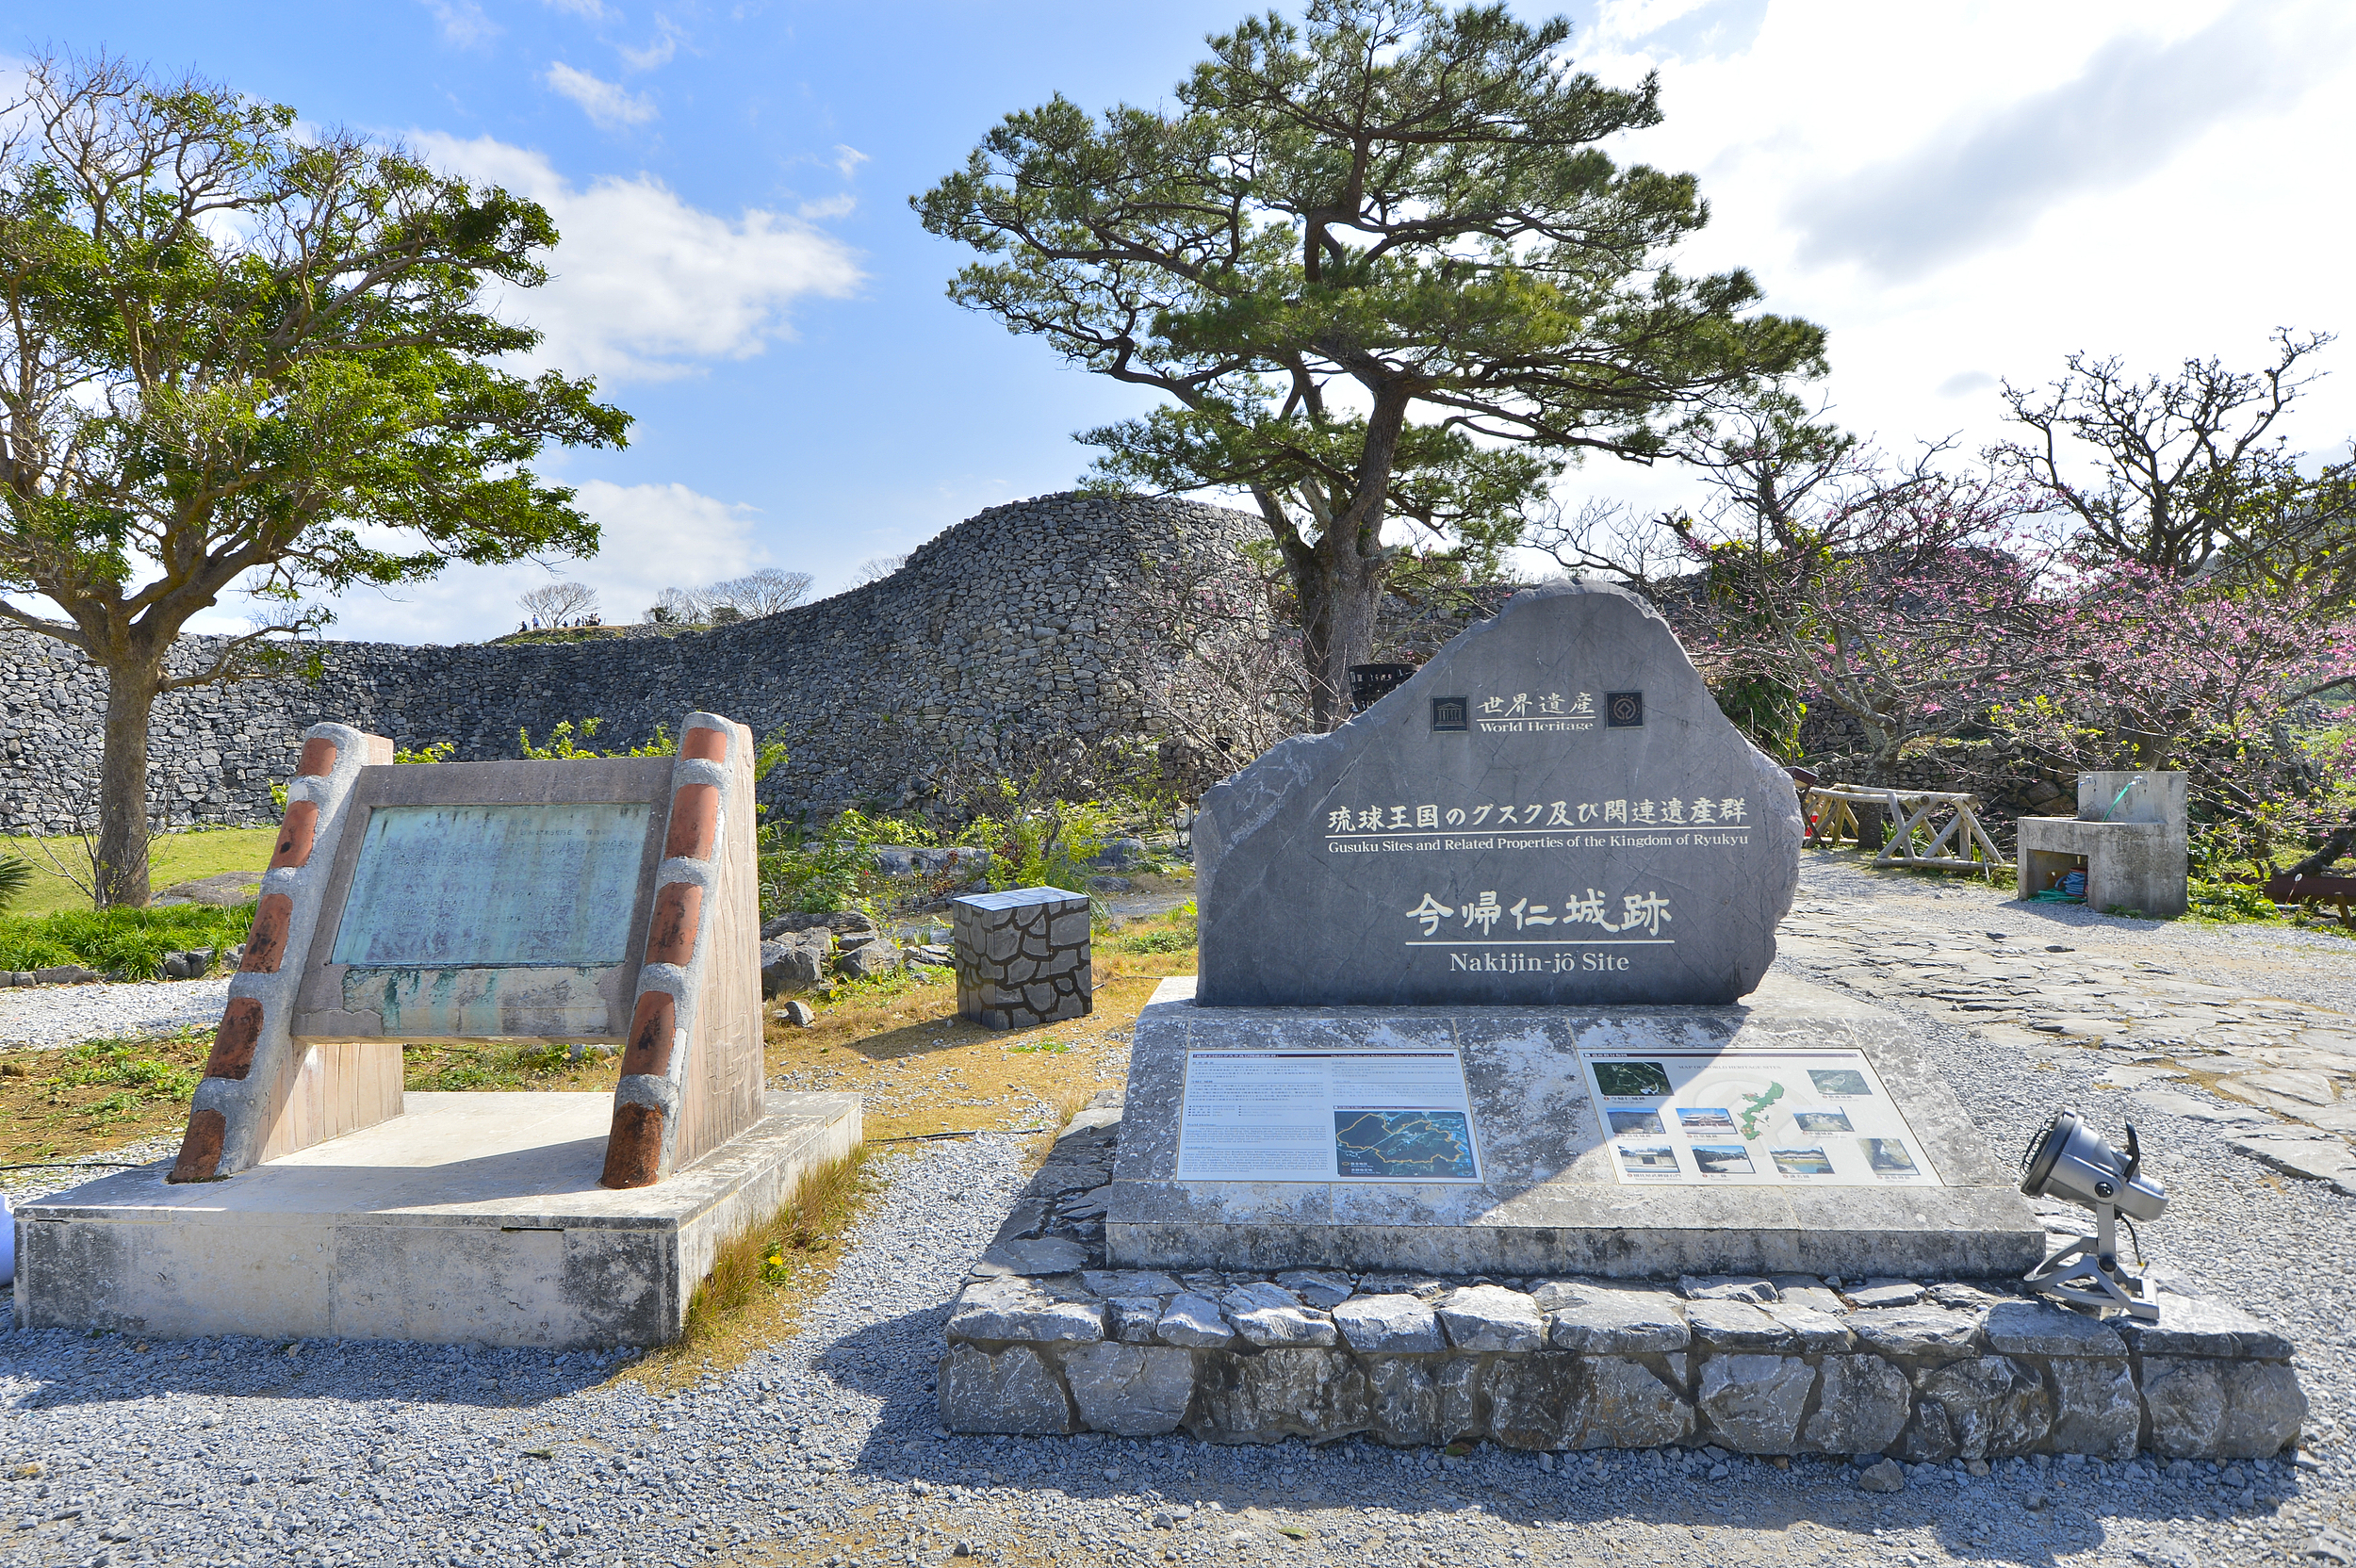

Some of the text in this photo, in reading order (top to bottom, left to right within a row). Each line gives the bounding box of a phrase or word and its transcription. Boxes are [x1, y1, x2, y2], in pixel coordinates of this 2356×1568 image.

[1476, 692, 1595, 718] 世界遺産
[1480, 721, 1594, 733] World Heritage
[1328, 797, 1748, 833] 琉球王国のグスク及び関連遺産群
[1328, 833, 1748, 853] Gusuku Sites and Related Properties of the Kingdom of Ryukyu
[1405, 888, 1673, 937] 今帰仁城跡
[1581, 952, 1630, 972] Site
